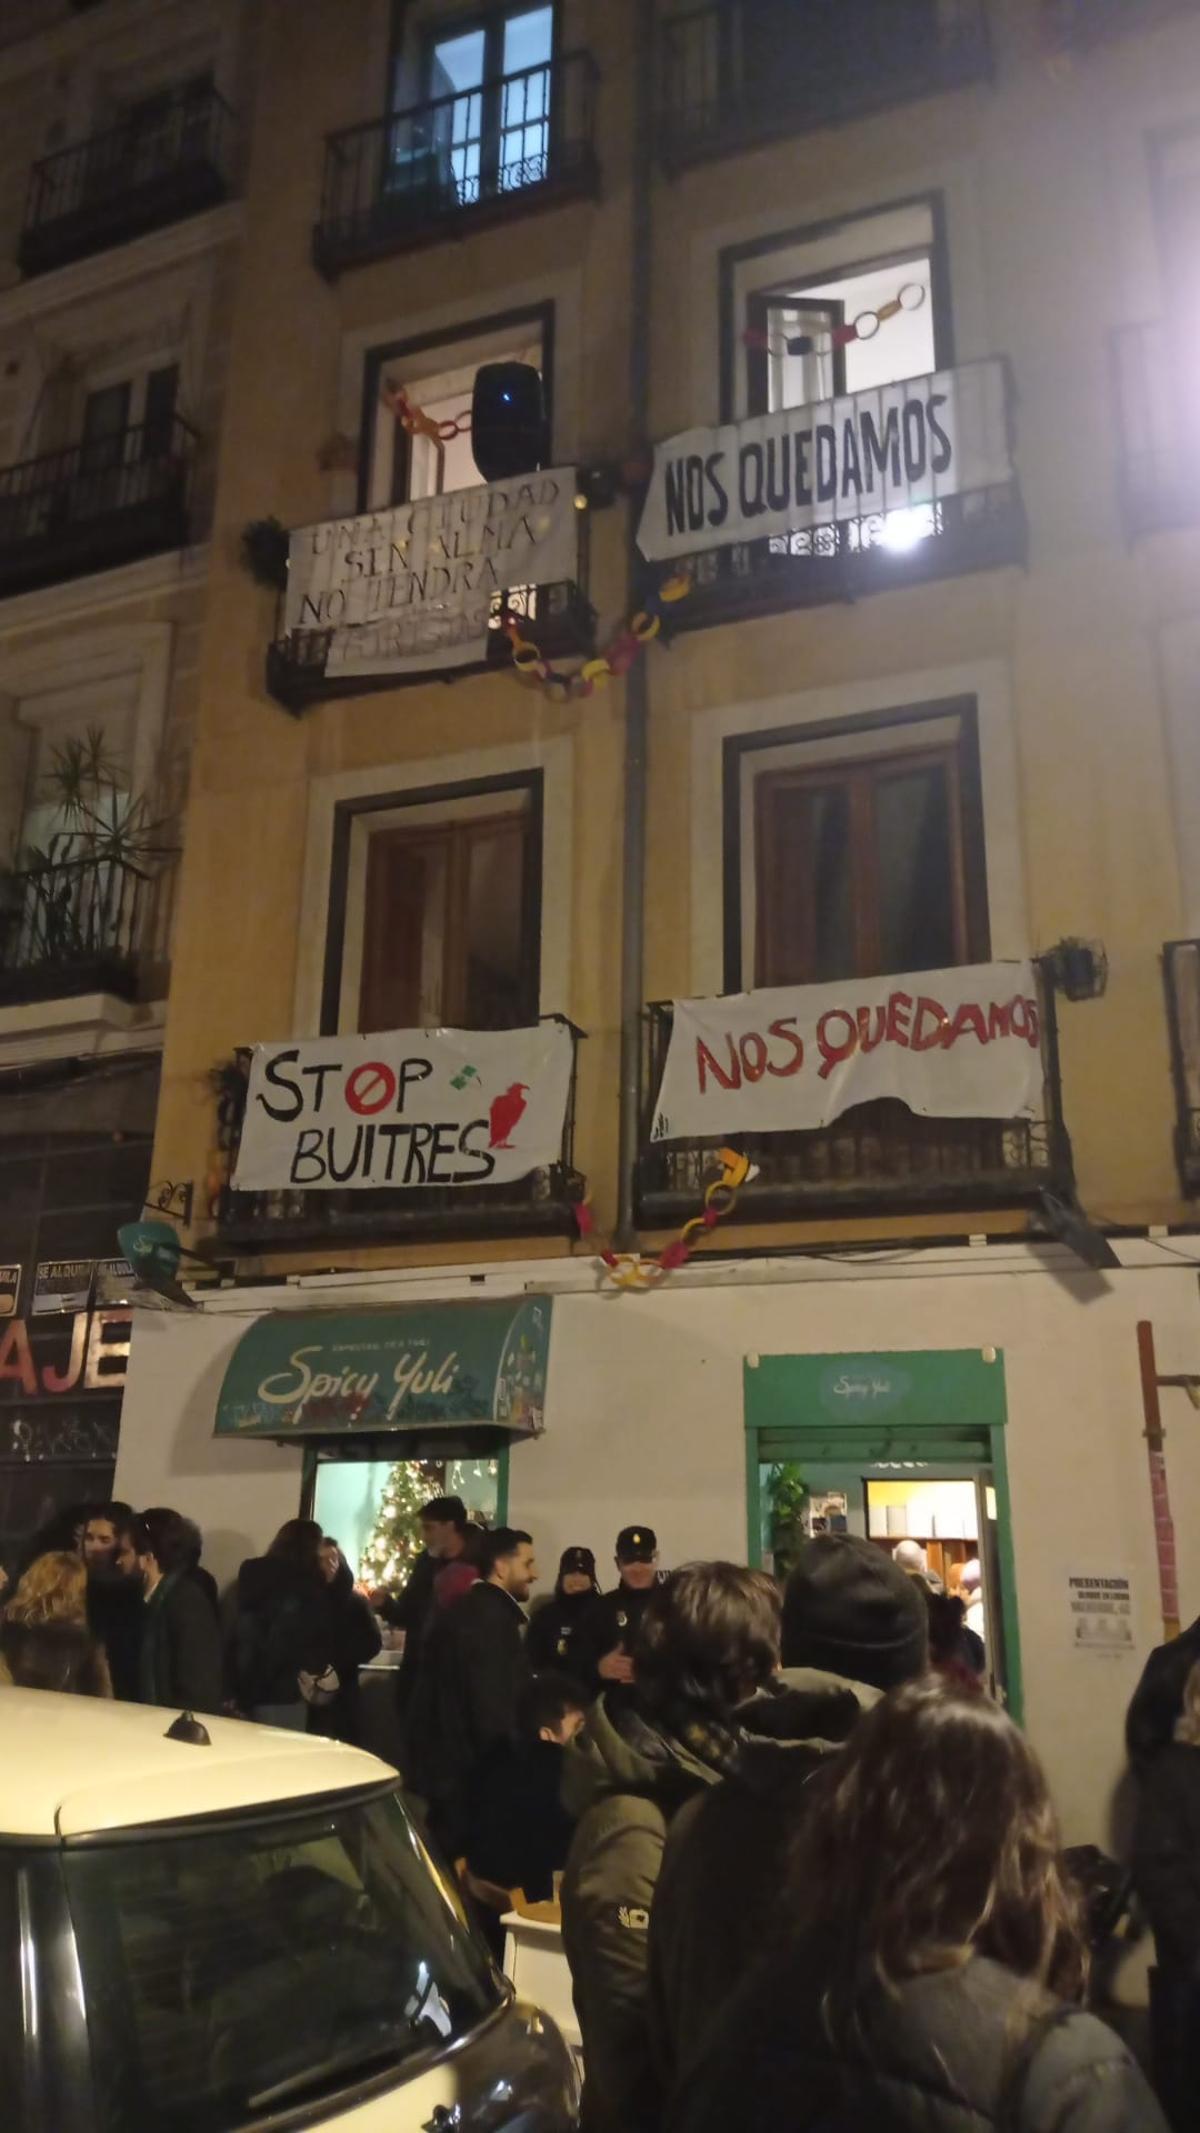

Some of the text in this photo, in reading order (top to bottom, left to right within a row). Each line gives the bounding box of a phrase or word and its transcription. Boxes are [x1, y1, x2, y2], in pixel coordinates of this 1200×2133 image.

[664, 394, 953, 537] NOS QUEDAMOS
[344, 537, 412, 579] SIN
[299, 588, 346, 626] NO
[696, 990, 1041, 1094] NOS QUEDAMOS
[255, 1049, 434, 1123] STOP
[289, 1118, 496, 1184] BUITRES
[257, 1346, 379, 1424] Spicy
[385, 1352, 459, 1421] Yuli
